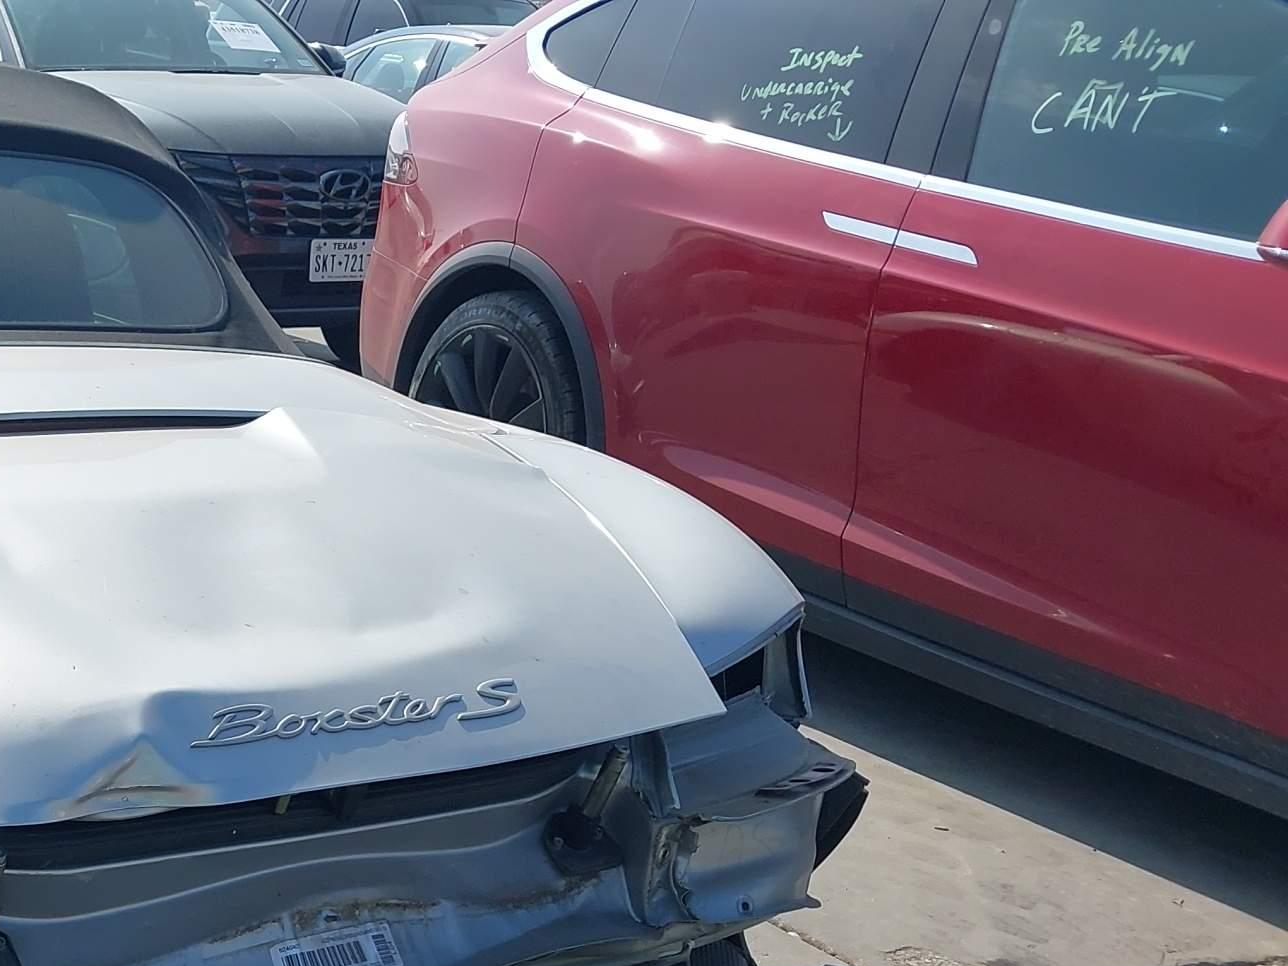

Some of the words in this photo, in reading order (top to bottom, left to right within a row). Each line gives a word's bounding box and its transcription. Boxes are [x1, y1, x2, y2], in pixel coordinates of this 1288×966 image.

[333, 242, 358, 250] TEXAS
[190, 690, 464, 749] Boxster
[457, 677, 523, 721] S
